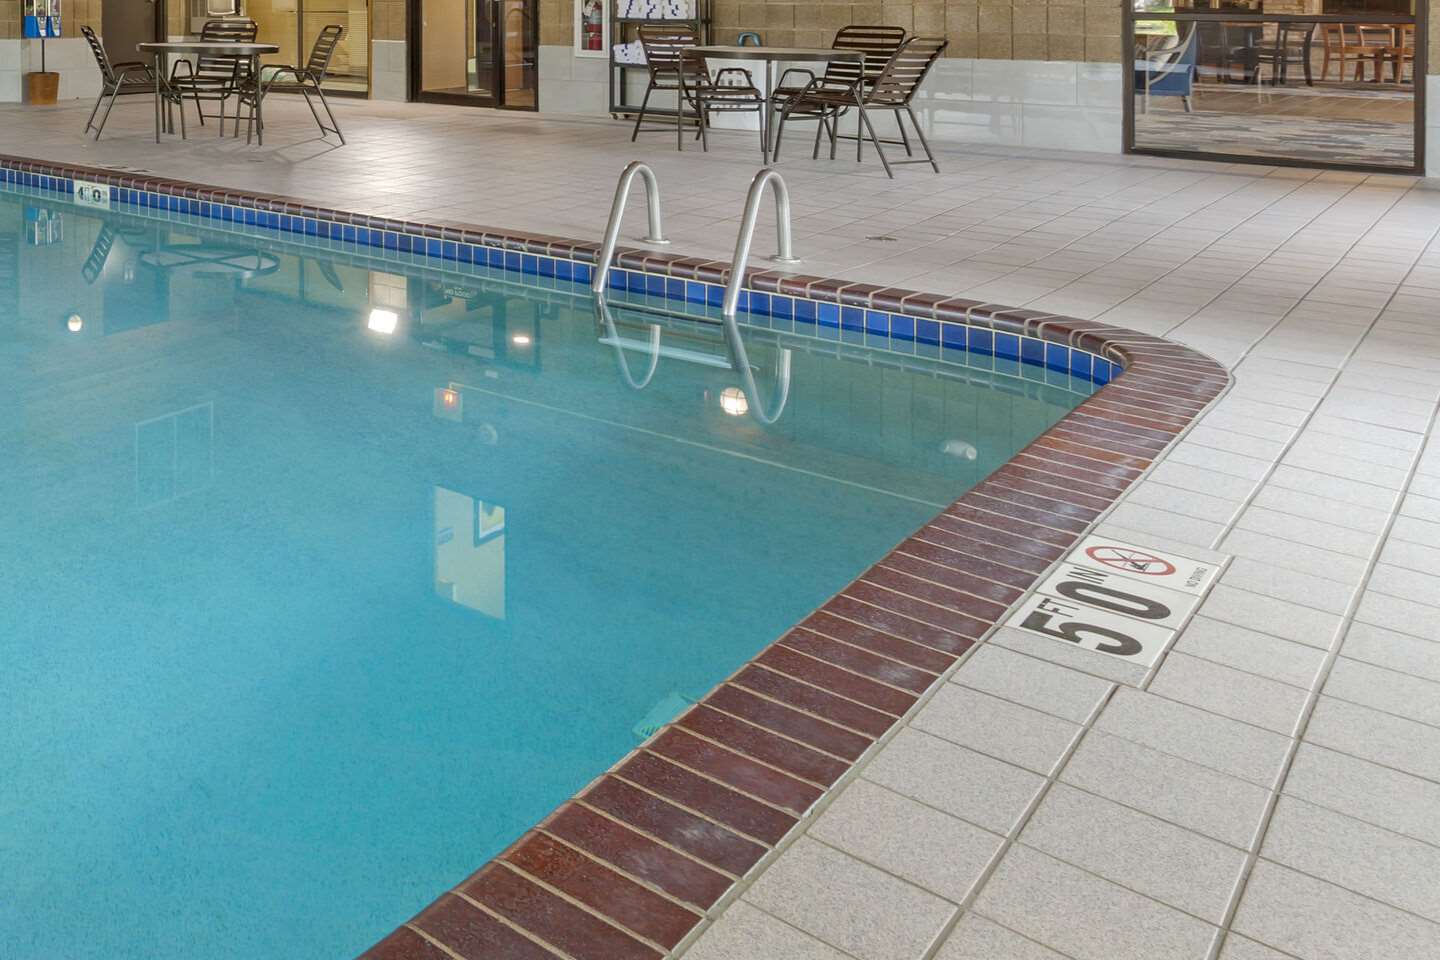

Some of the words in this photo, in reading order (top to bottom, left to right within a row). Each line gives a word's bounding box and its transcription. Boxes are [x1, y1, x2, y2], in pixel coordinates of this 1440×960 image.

[1066, 566, 1109, 585] IN
[1036, 597, 1080, 618] FT
[1055, 580, 1171, 620] 0
[1019, 611, 1143, 656] 5
